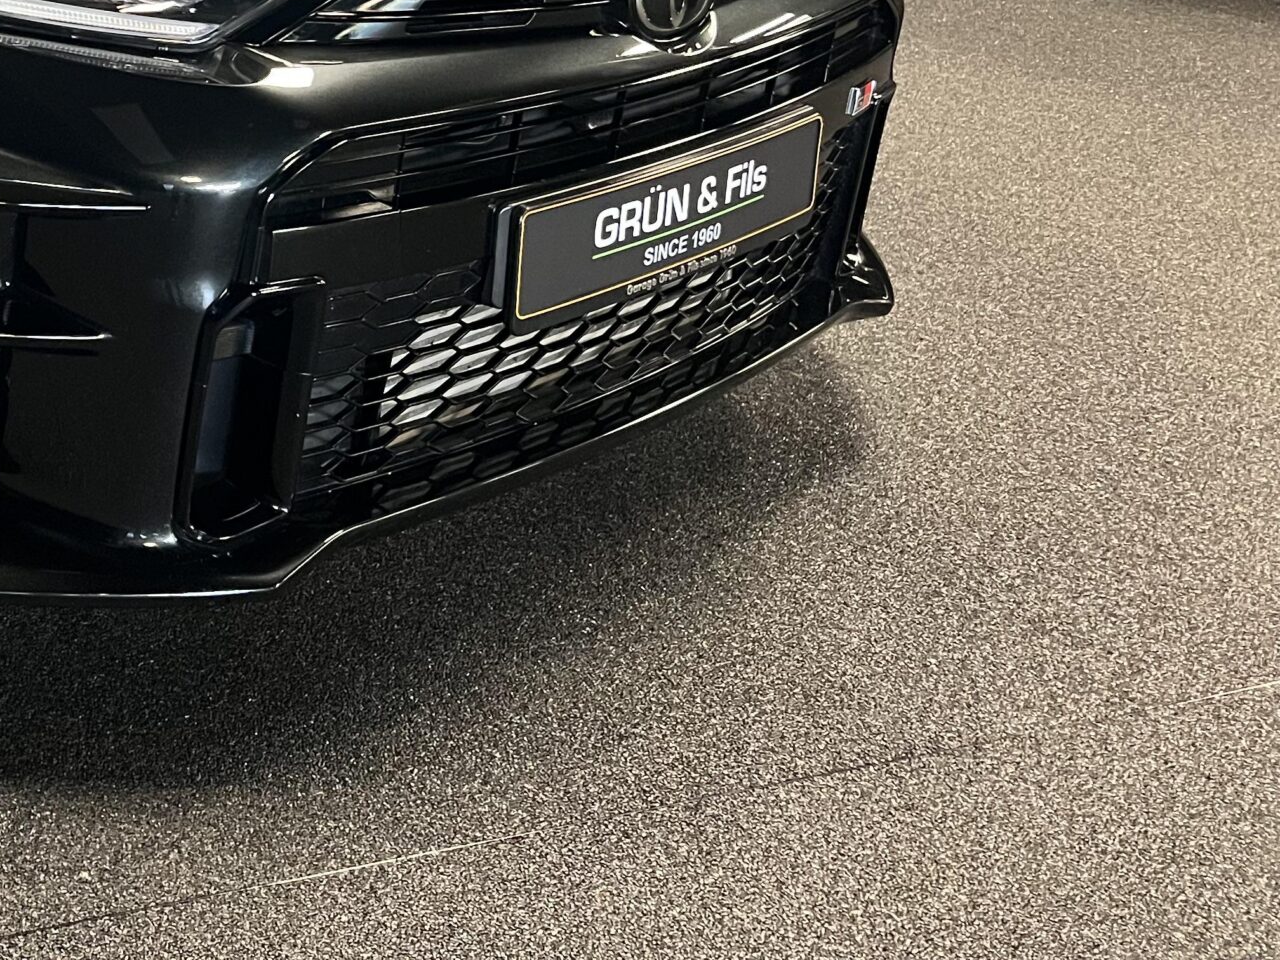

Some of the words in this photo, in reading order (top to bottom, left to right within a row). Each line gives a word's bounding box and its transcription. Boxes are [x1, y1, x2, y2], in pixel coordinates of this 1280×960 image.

[594, 183, 691, 249] GRÜN
[697, 175, 718, 214] &
[724, 159, 768, 205] Fils
[643, 235, 689, 266] SINCE
[691, 222, 722, 249] 1960
[626, 278, 657, 295] Garage
